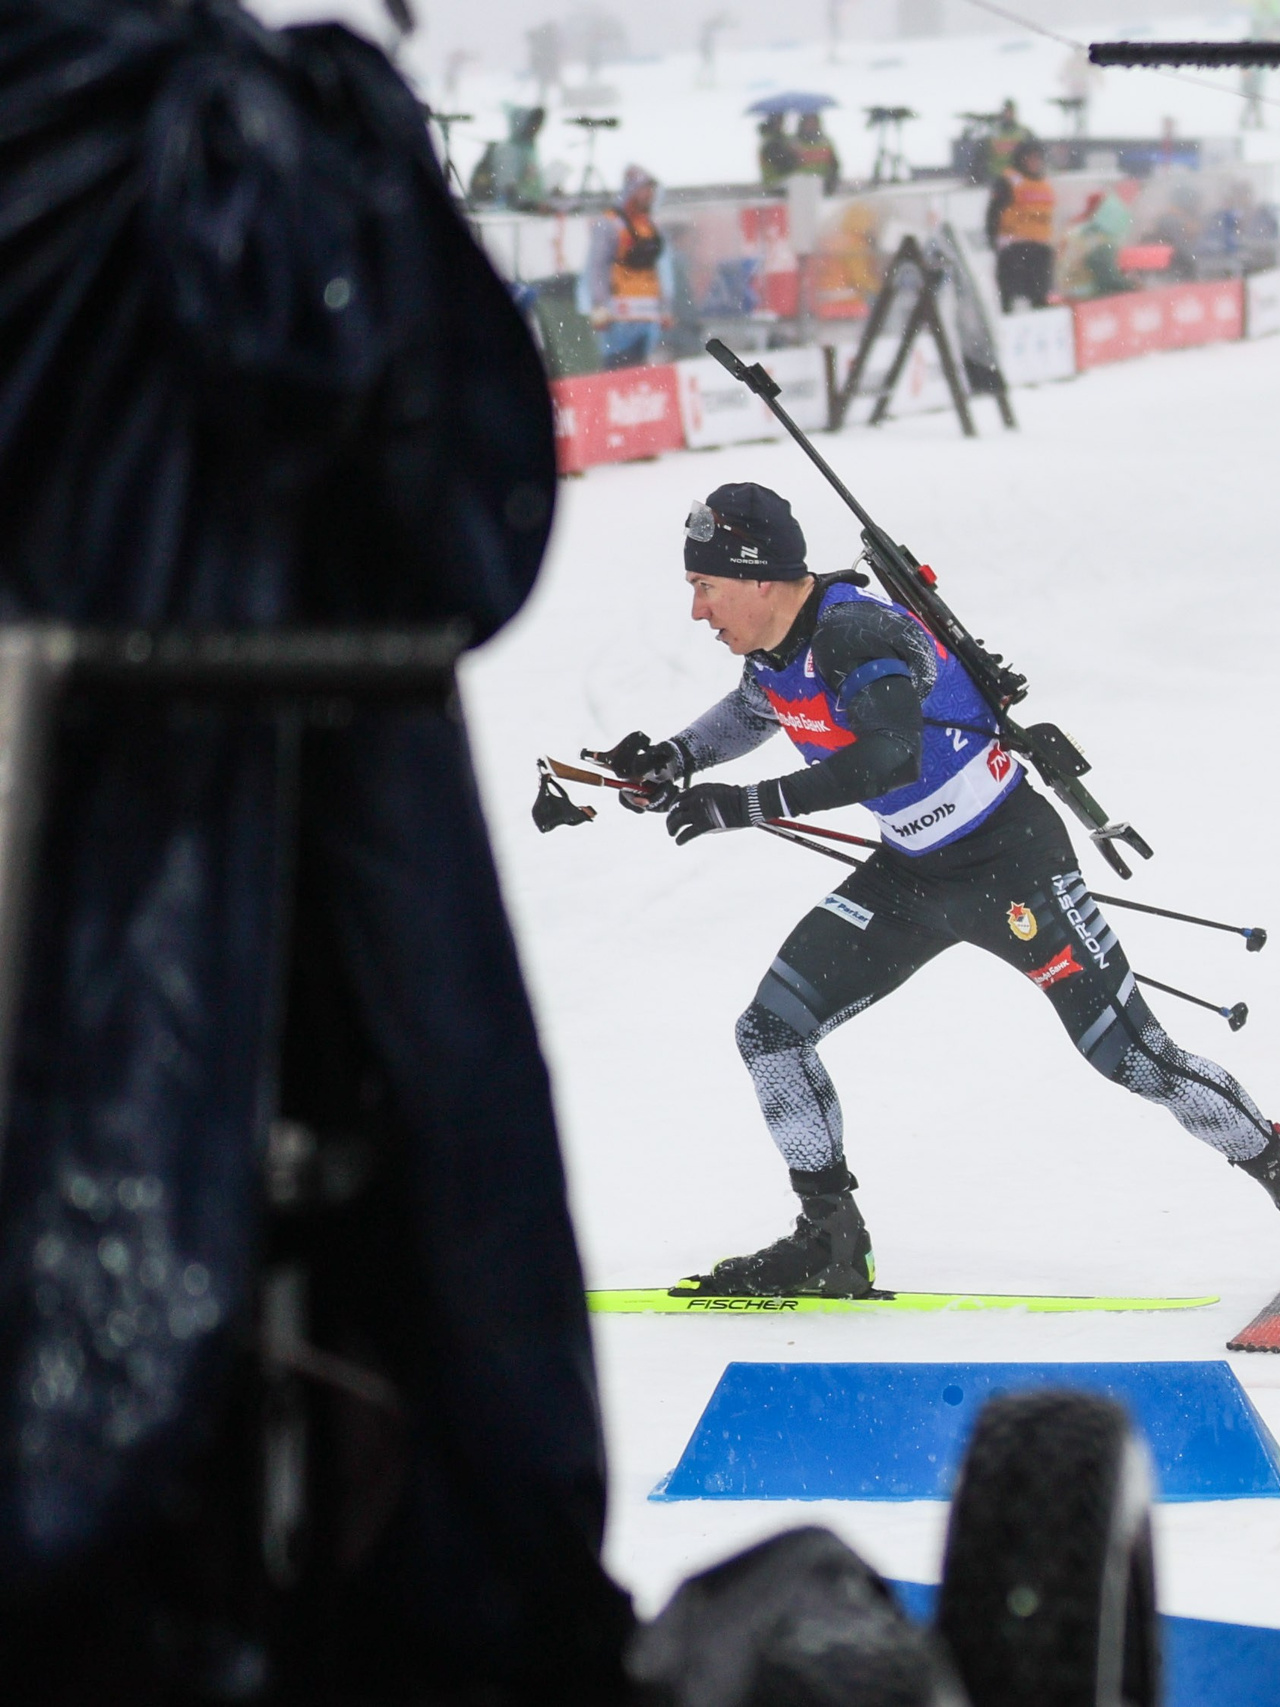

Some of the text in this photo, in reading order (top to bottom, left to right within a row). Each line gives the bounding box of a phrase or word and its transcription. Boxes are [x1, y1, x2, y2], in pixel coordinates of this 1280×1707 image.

[799, 713, 831, 733] Банк
[838, 903, 868, 922] Parker
[1051, 874, 1110, 970] NORDSKI
[1047, 959, 1070, 976] Банк
[686, 1299, 799, 1311] FISCHER
